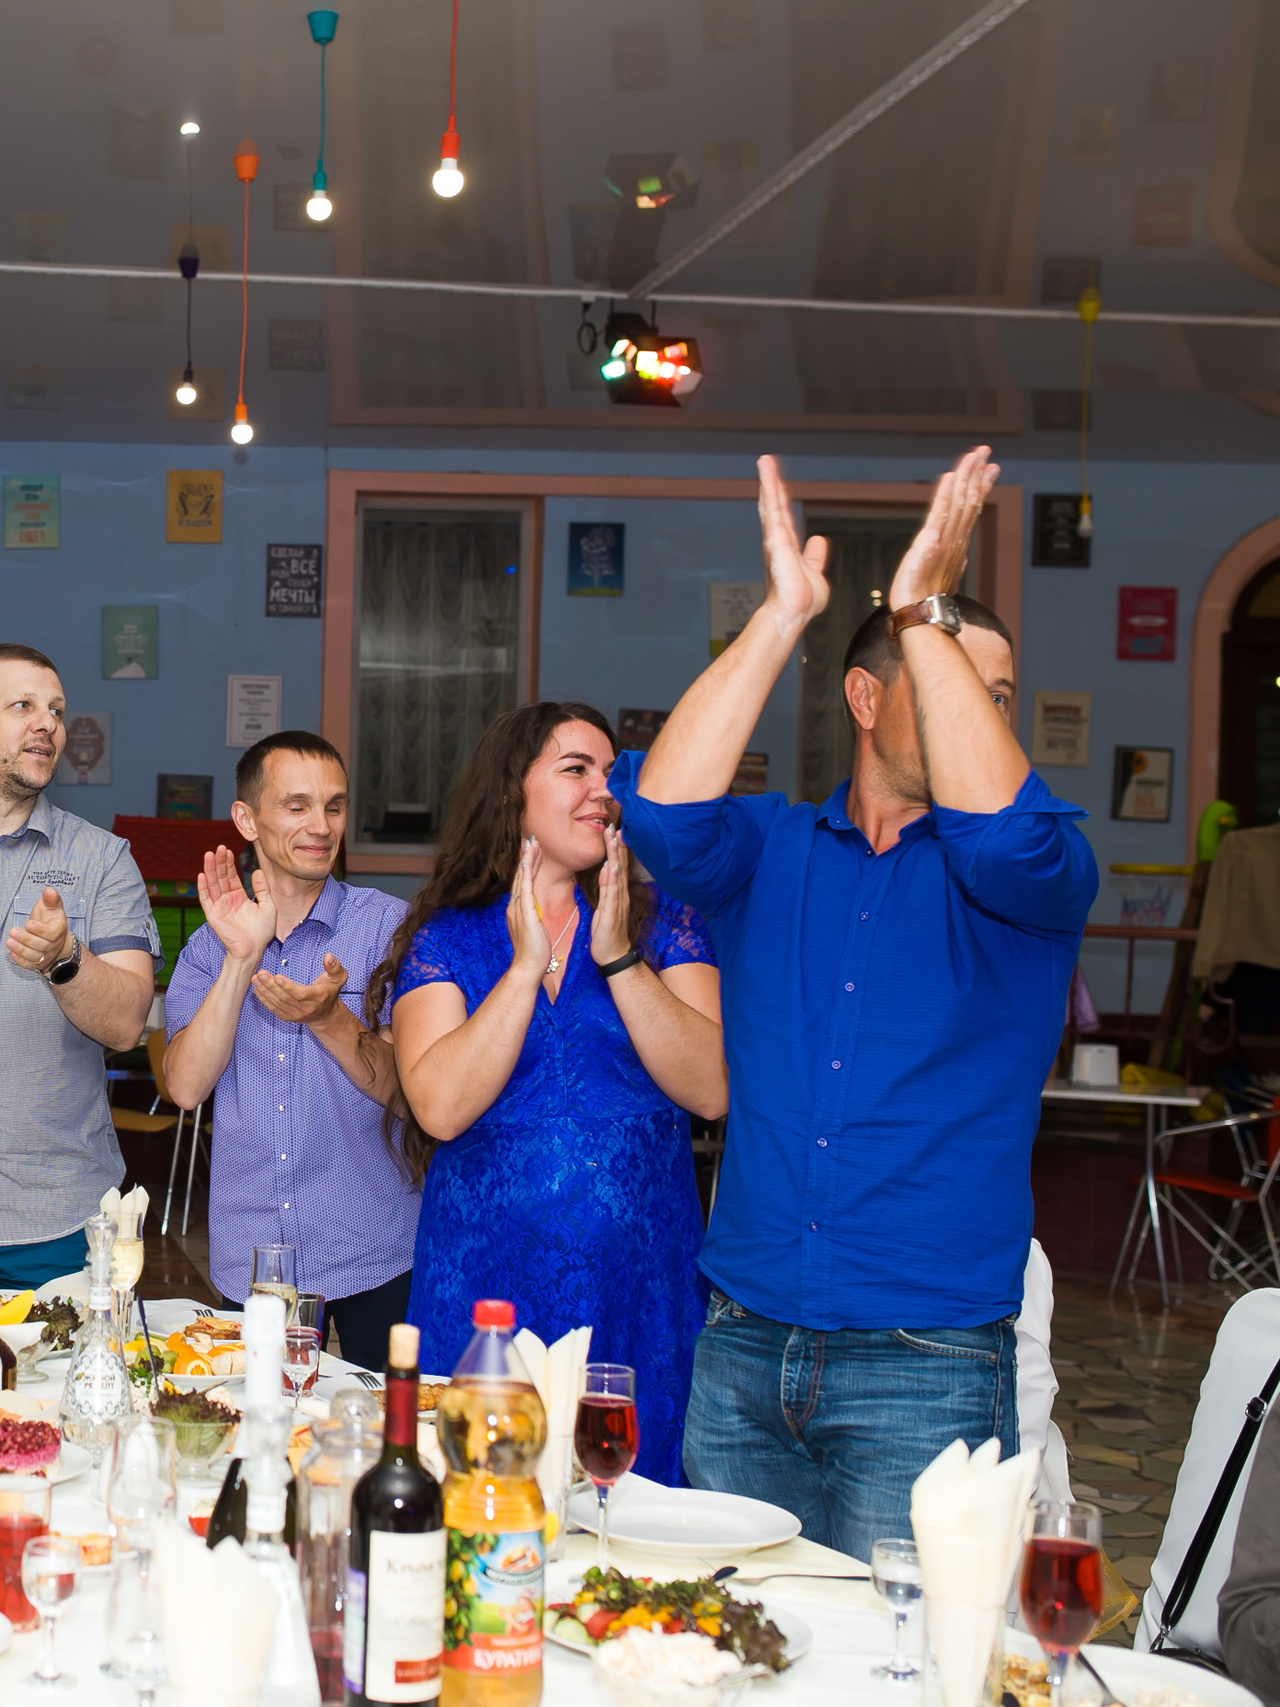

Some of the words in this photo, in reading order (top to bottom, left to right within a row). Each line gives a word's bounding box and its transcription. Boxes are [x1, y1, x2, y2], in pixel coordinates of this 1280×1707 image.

[270, 588, 316, 604] МЕЧТЫ
[84, 1382, 114, 1390] РЕЕПТ
[474, 1644, 542, 1670] БУРАТИН
